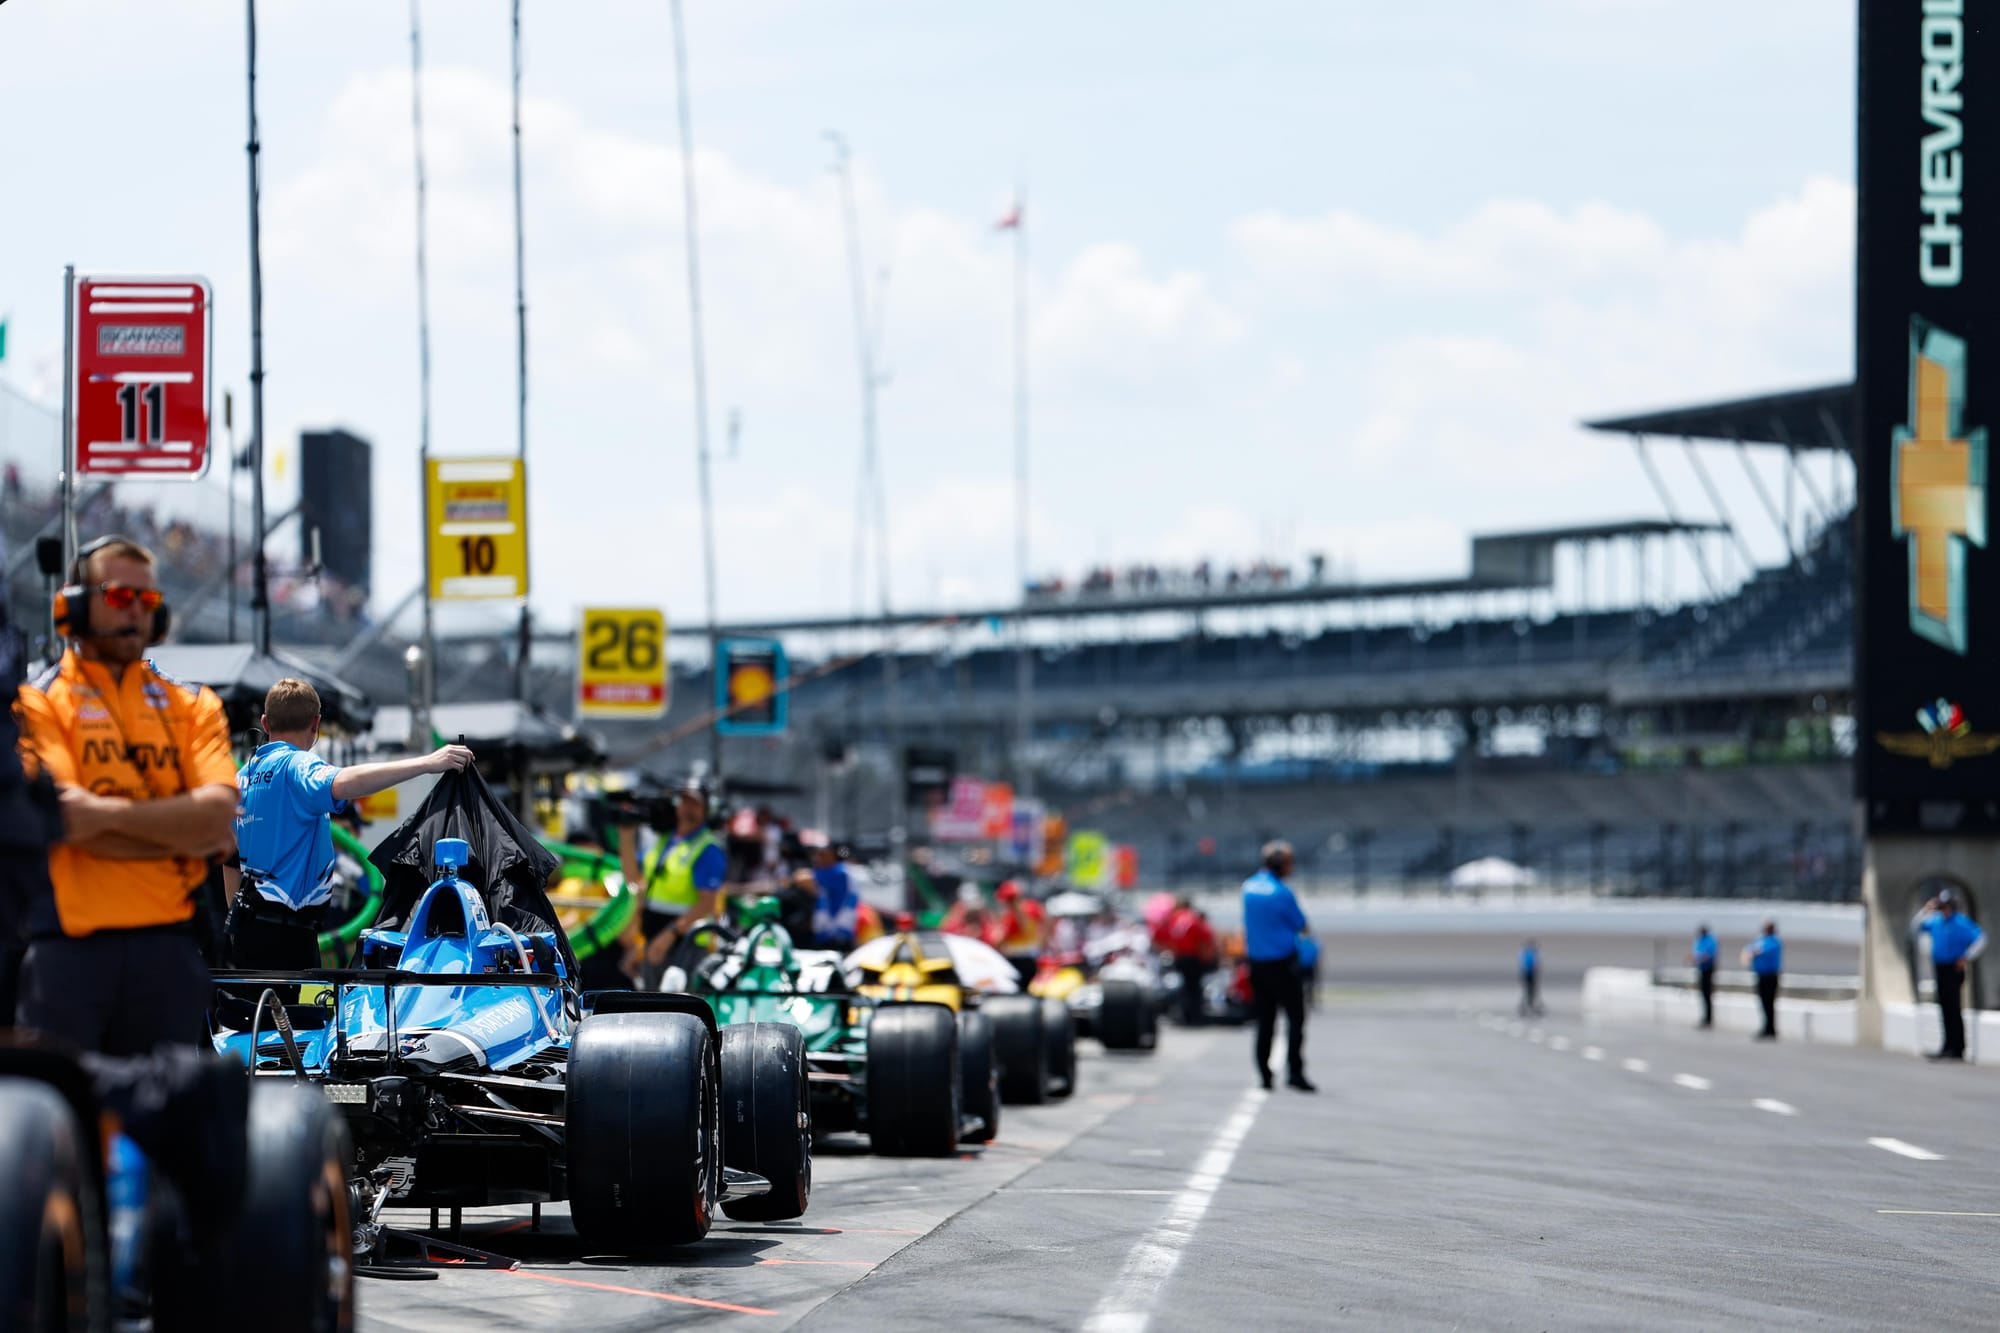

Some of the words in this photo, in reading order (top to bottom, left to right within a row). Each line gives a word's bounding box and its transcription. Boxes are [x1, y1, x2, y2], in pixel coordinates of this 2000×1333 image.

[116, 382, 166, 446] 11
[457, 535, 497, 576] 10
[587, 616, 660, 673] 26
